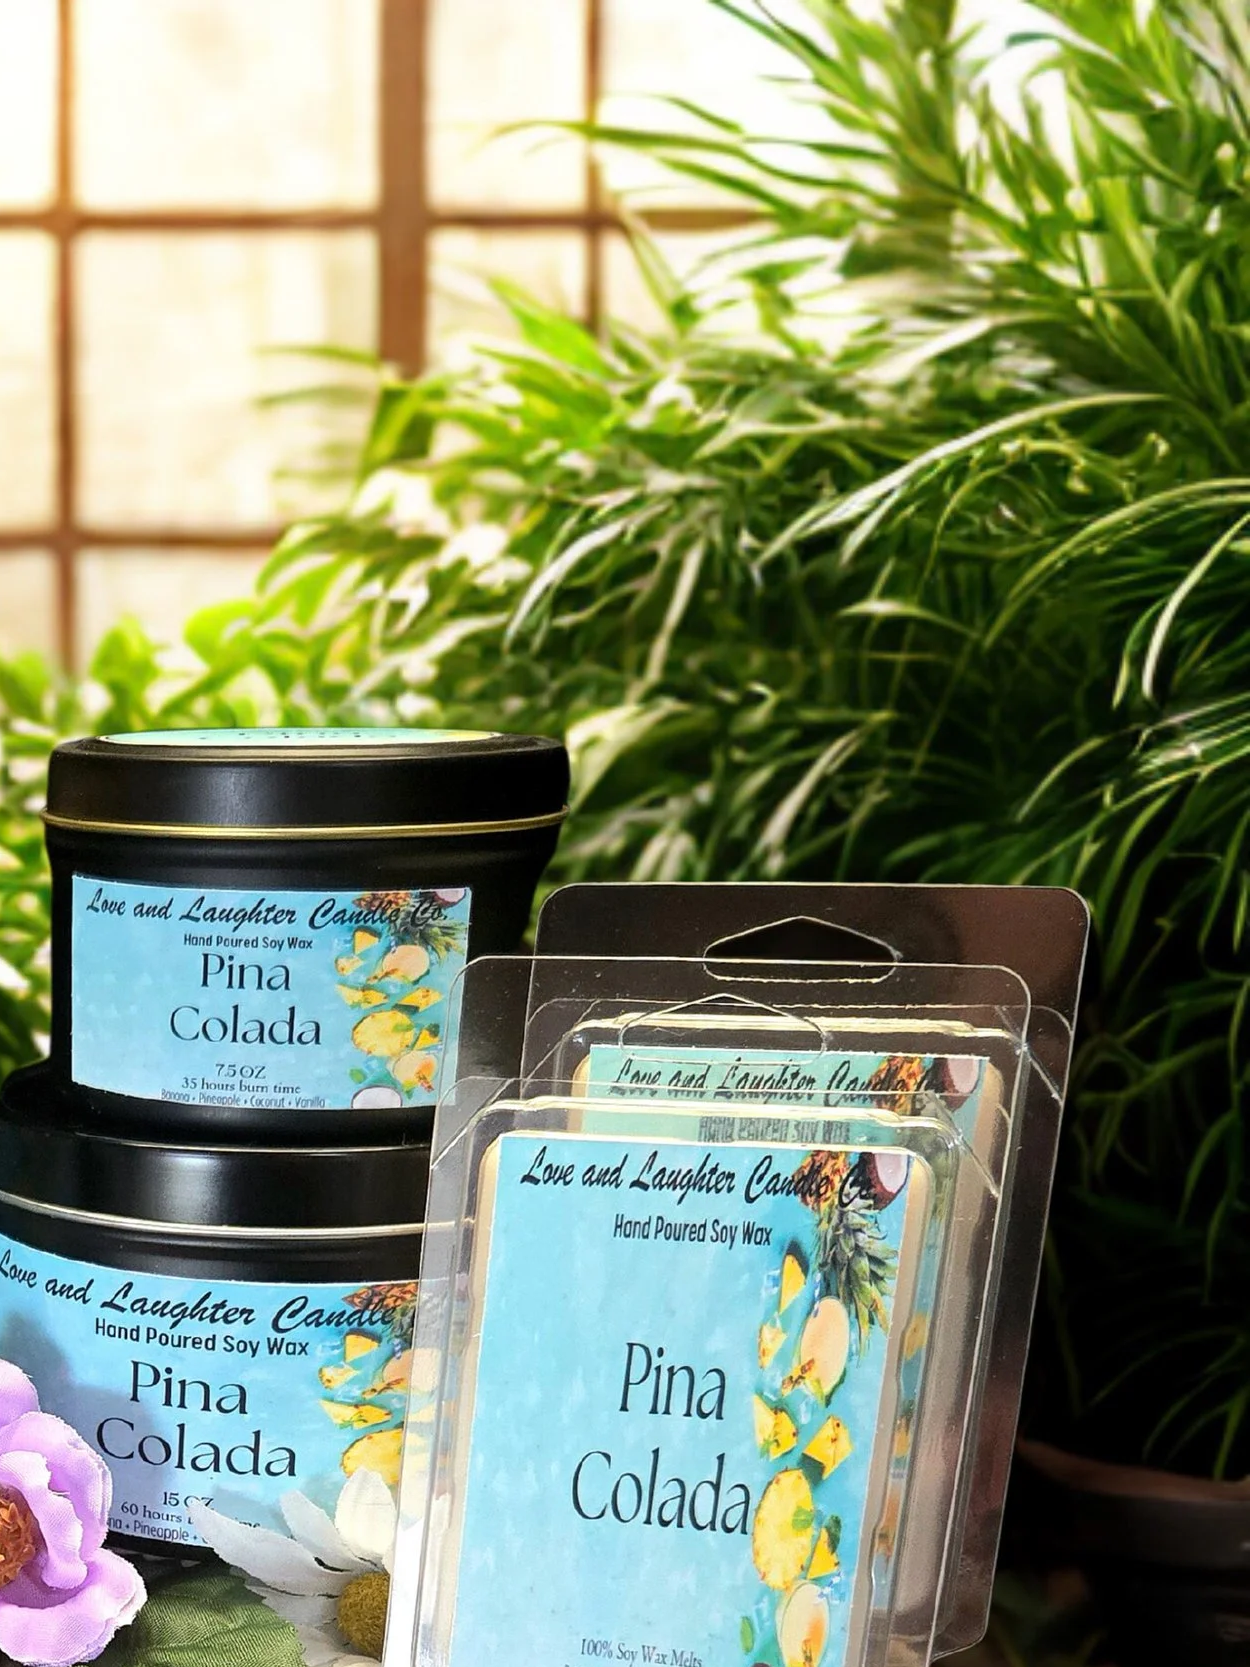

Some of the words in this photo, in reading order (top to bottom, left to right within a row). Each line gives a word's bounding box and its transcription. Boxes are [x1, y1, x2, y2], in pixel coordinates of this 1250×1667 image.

[86, 888, 126, 916] Love
[134, 898, 172, 920] and
[179, 895, 298, 932] Laughter
[309, 898, 401, 929] Candle
[183, 933, 212, 946] Hand
[216, 936, 259, 949] Poured
[262, 936, 285, 952] Soy
[287, 937, 313, 949] Wax
[201, 953, 290, 991] Pina
[170, 1004, 322, 1046] Colada
[182, 1077, 197, 1089] 35
[201, 1077, 236, 1092] hours
[239, 1080, 269, 1092] burn
[273, 1083, 301, 1094] time
[240, 1065, 266, 1079] OZ
[520, 1146, 574, 1187] Love
[582, 1154, 628, 1190] and
[630, 1150, 736, 1204] Laughter
[745, 1154, 831, 1204] Candle
[613, 1214, 651, 1240] Hand
[655, 1217, 706, 1244] Poured
[711, 1219, 738, 1250] Soy
[742, 1222, 773, 1246] Wax
[45, 1278, 94, 1304] and
[100, 1282, 256, 1329] Laughter
[272, 1295, 396, 1334] Candle
[95, 1317, 140, 1342] Hand
[146, 1326, 216, 1350] Poured
[223, 1334, 261, 1358] Soy
[266, 1337, 309, 1356] Wax
[130, 1361, 247, 1415] Pina
[618, 1341, 727, 1421] Pina
[96, 1418, 296, 1477] Colada
[163, 1491, 181, 1507] 15
[572, 1448, 751, 1534] Colada
[121, 1502, 139, 1516] 60
[143, 1506, 183, 1524] hours
[580, 1638, 613, 1659] 100%
[616, 1642, 638, 1666] Soy
[641, 1646, 668, 1666] Wax
